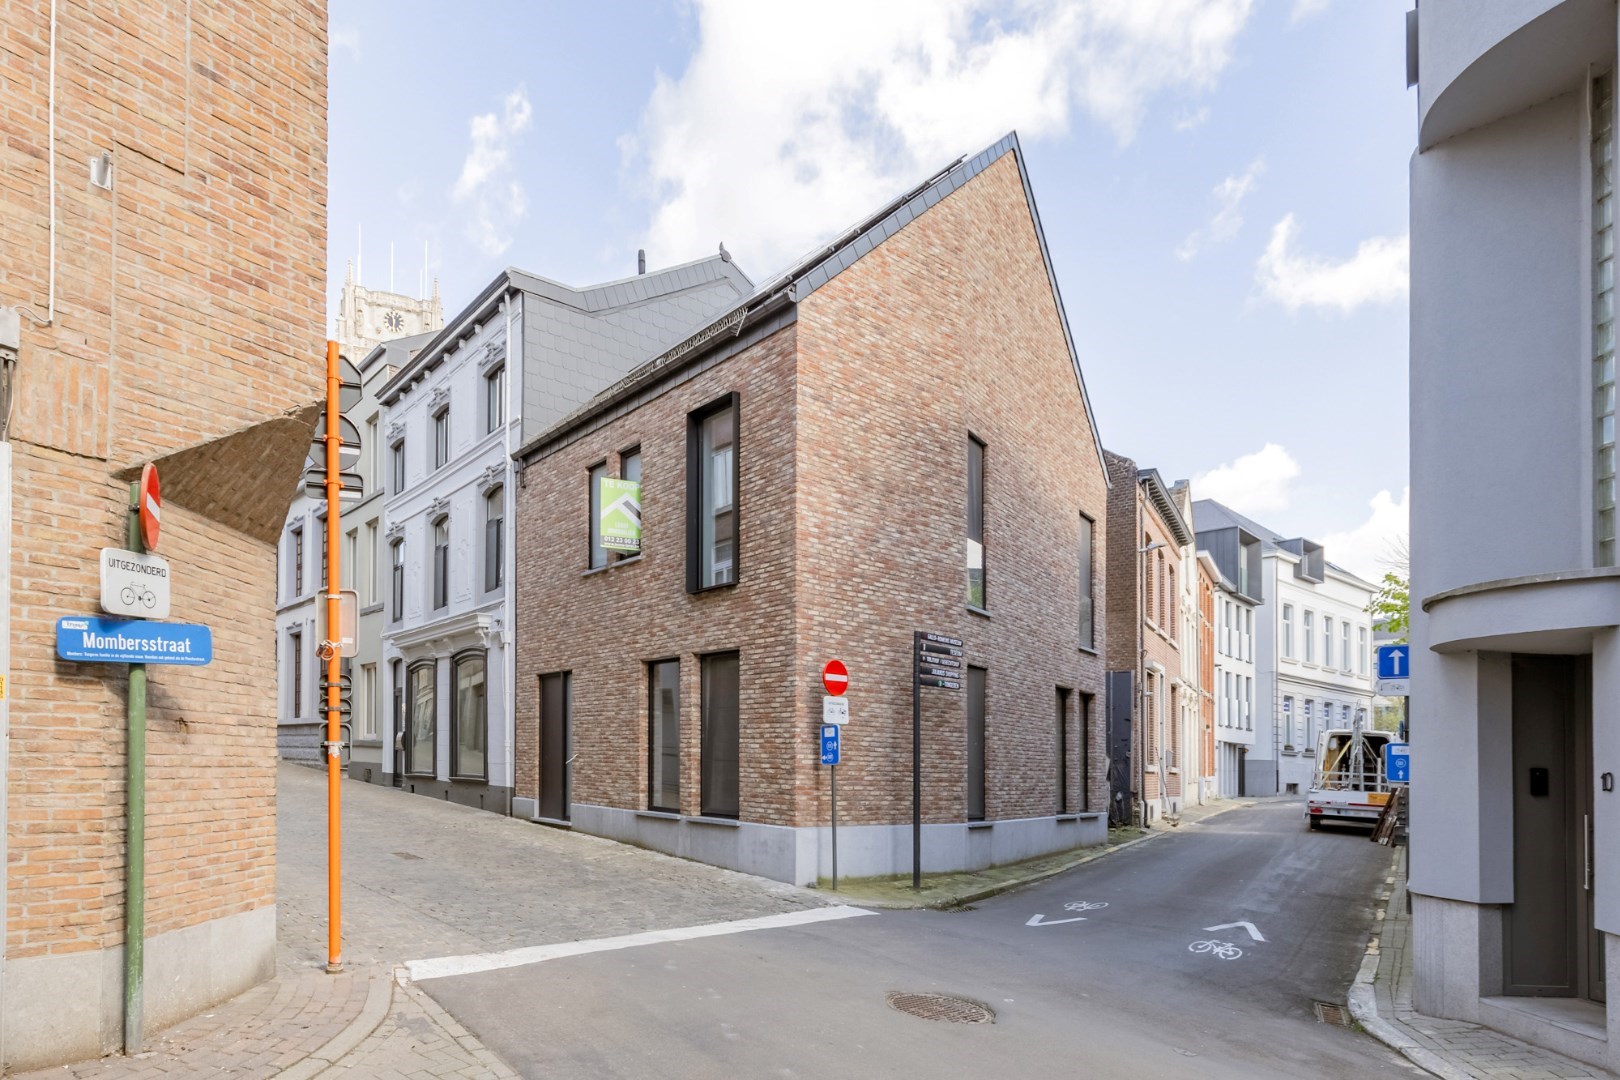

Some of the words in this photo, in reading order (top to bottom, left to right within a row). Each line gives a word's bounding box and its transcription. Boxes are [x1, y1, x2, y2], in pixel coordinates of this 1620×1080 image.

[604, 480, 614, 488] TE
[617, 481, 640, 489] KOOP
[108, 557, 167, 578] UITGEZONDERD
[82, 631, 191, 653] Mombersstraat
[1600, 772, 1613, 792] 10
